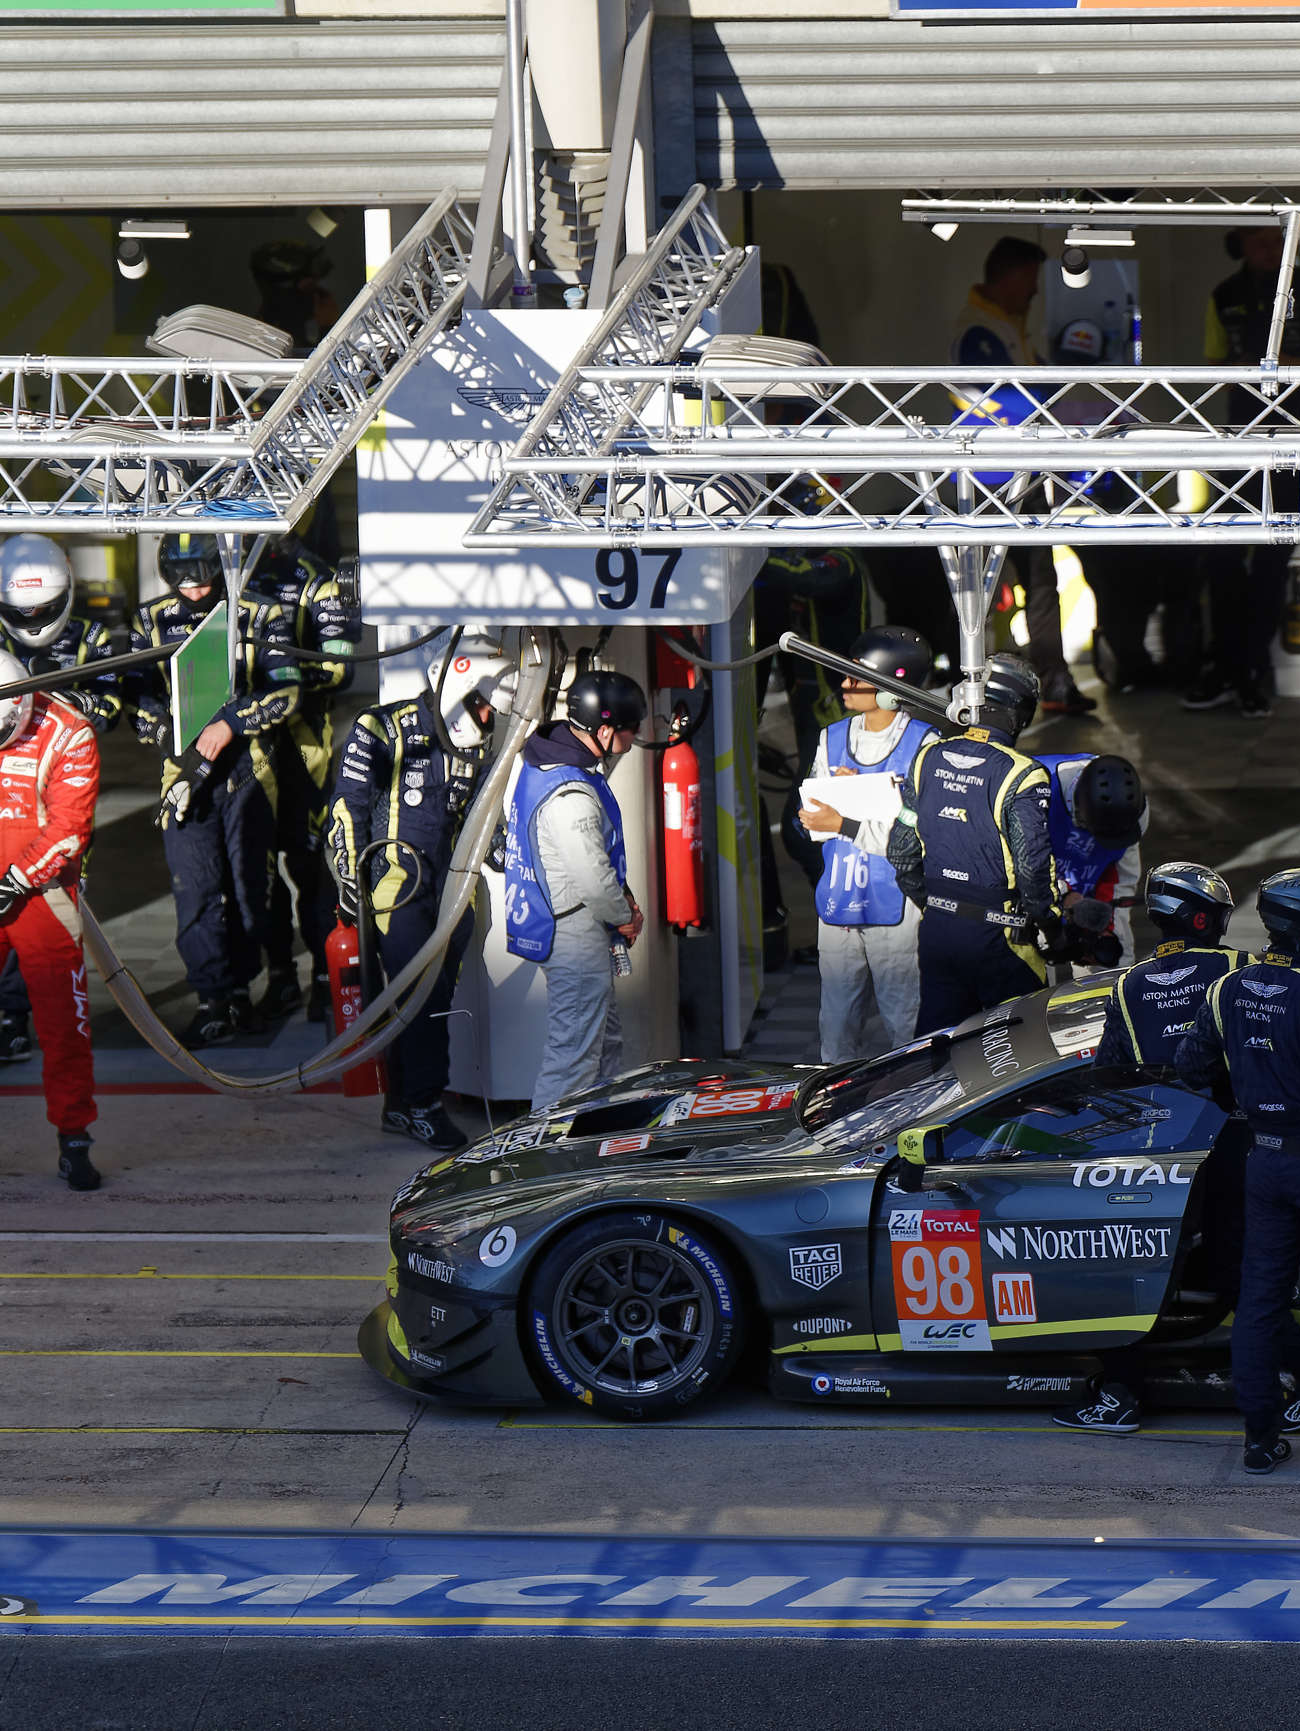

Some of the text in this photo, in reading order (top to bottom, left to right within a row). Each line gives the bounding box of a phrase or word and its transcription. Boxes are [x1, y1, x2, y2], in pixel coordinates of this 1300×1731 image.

[595, 547, 682, 610] 97
[927, 896, 957, 912] sparco
[1142, 983, 1205, 1001] ASTON MARTIN
[1157, 997, 1190, 1009] RACING
[1162, 1020, 1196, 1034] AMR
[1244, 1036, 1274, 1050] AMR
[982, 1029, 1020, 1078] RACING
[1070, 1163, 1191, 1188] TOTAL
[891, 1213, 976, 1233] 24h TOTAL
[794, 1248, 837, 1264] TAG
[690, 1245, 731, 1312] MICHELIN
[795, 1265, 839, 1287] HEUER
[902, 1246, 975, 1315] 98
[999, 1280, 1034, 1315] AM
[431, 1306, 447, 1321] ETT
[800, 1318, 847, 1334] DUPONT
[923, 1323, 976, 1339] WEC
[535, 1318, 573, 1385] MICHELIN
[835, 1377, 880, 1387] Royal Air Force
[835, 1385, 886, 1393] Benevolent Fund
